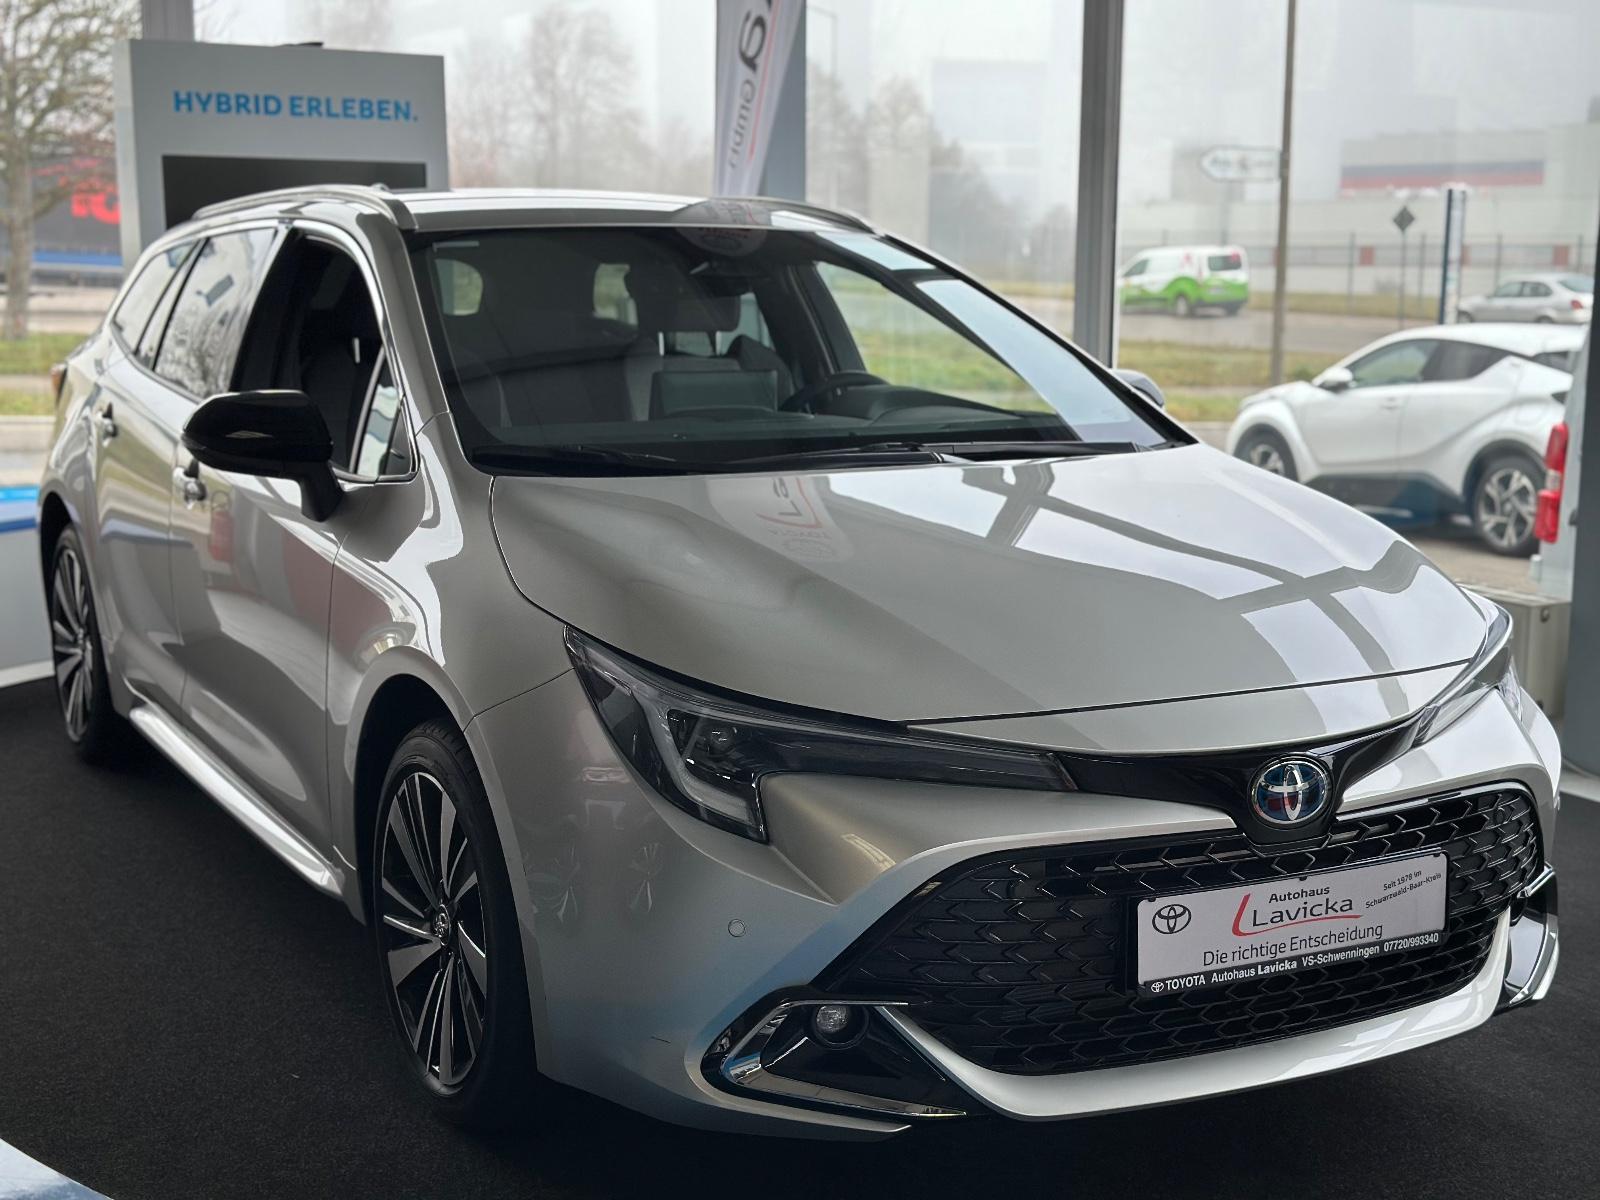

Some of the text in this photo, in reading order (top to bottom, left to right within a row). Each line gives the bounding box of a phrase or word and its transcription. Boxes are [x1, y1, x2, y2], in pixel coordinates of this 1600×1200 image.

[173, 90, 419, 122] HYBRID ERLEBEN.
[1268, 886, 1330, 903] Autohaus
[1365, 872, 1442, 909] Schwarzwald-Baar-Kreis
[1383, 880, 1397, 891] Seit
[1397, 872, 1413, 886] 1978
[1252, 897, 1353, 927] Lavicka
[1165, 932, 1439, 991] TOYOTA Autohaus Lavicka VS-Schwenningen 07720/993340
[1203, 925, 1383, 966] Die richtige Entscheidung
